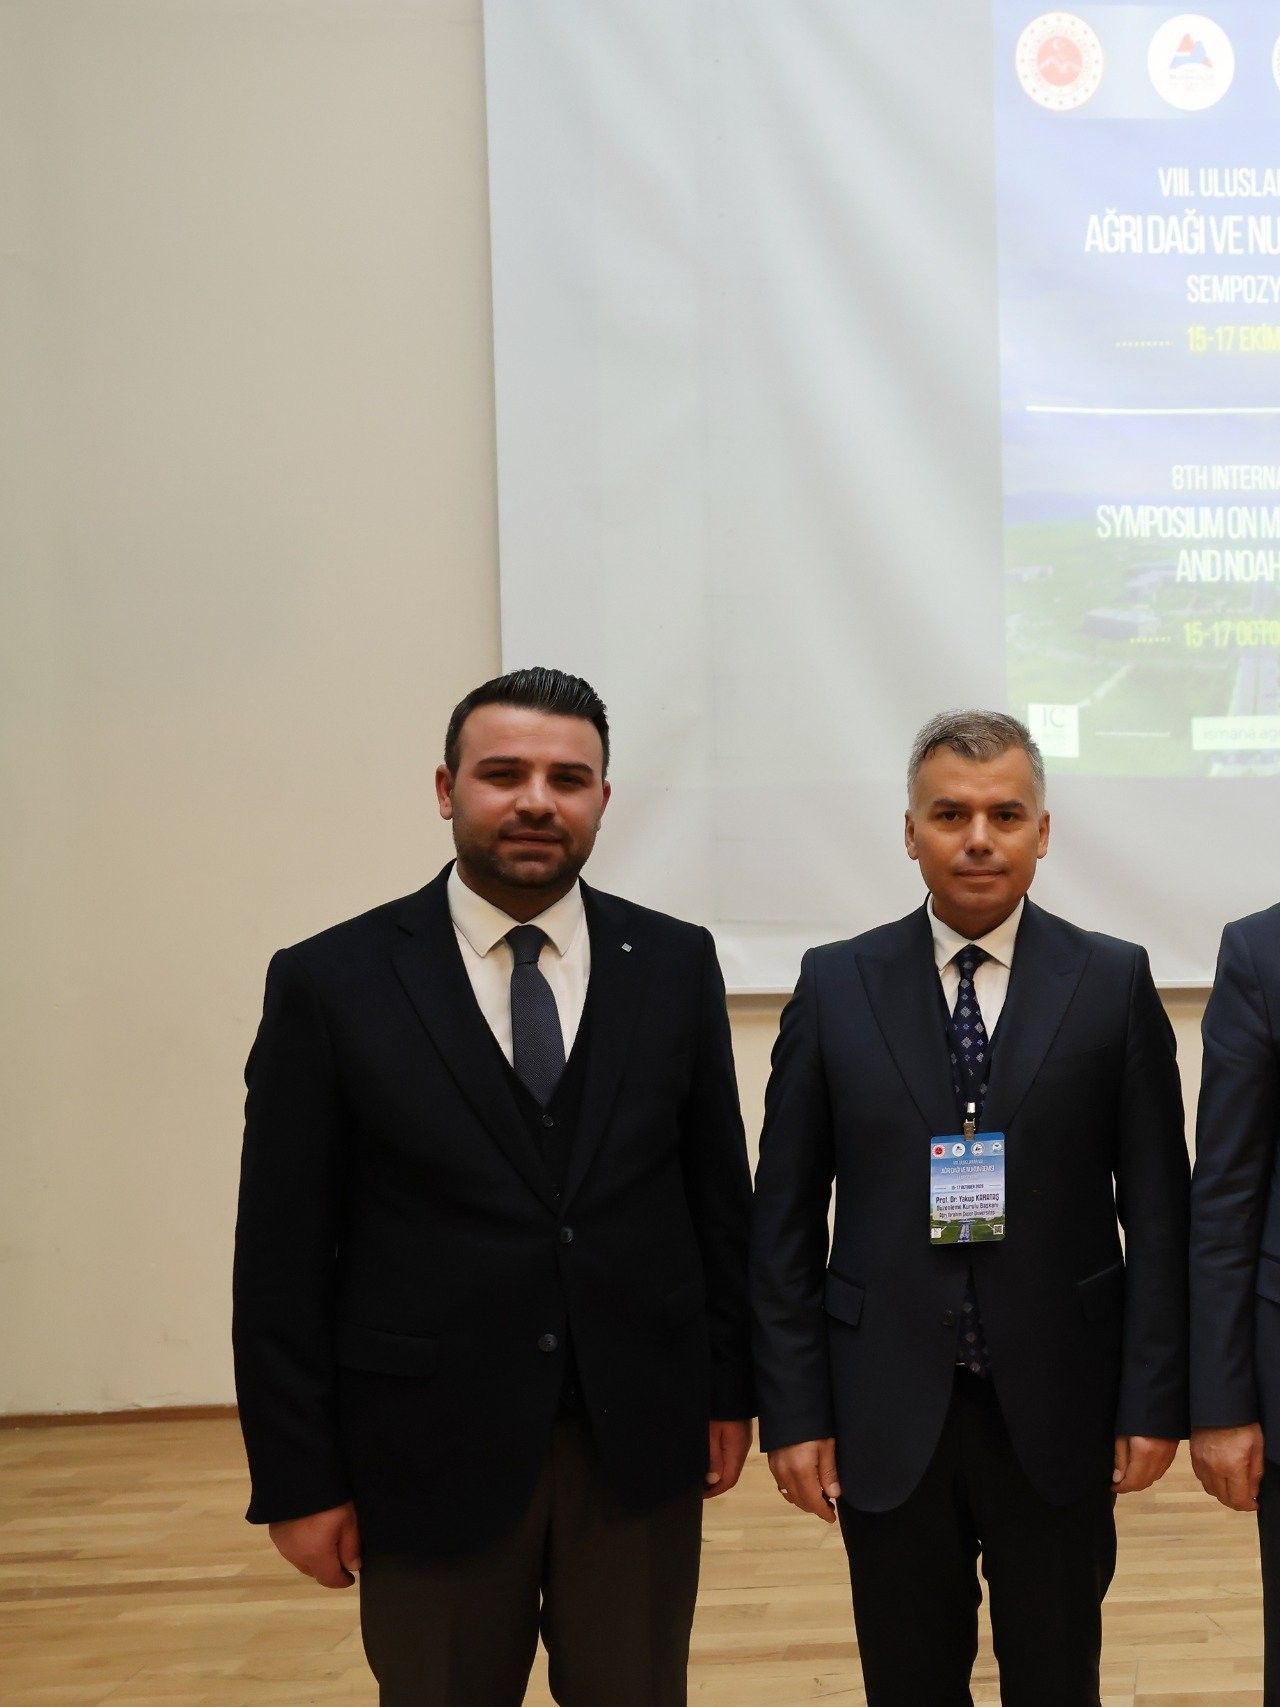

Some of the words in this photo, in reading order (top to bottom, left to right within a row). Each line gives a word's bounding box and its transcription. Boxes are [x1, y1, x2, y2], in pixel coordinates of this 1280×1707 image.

[1158, 167, 1195, 198] VIII.
[1084, 208, 1143, 254] AĞRI
[1146, 208, 1205, 255] DAĞI
[1209, 215, 1244, 255] VE
[1187, 325, 1235, 352] 15-17
[1171, 465, 1208, 490] 8TH
[1096, 504, 1225, 538] SYMPOSIUM
[1228, 505, 1257, 539] ON
[1175, 549, 1221, 583] AND
[1184, 620, 1232, 648] 15-17
